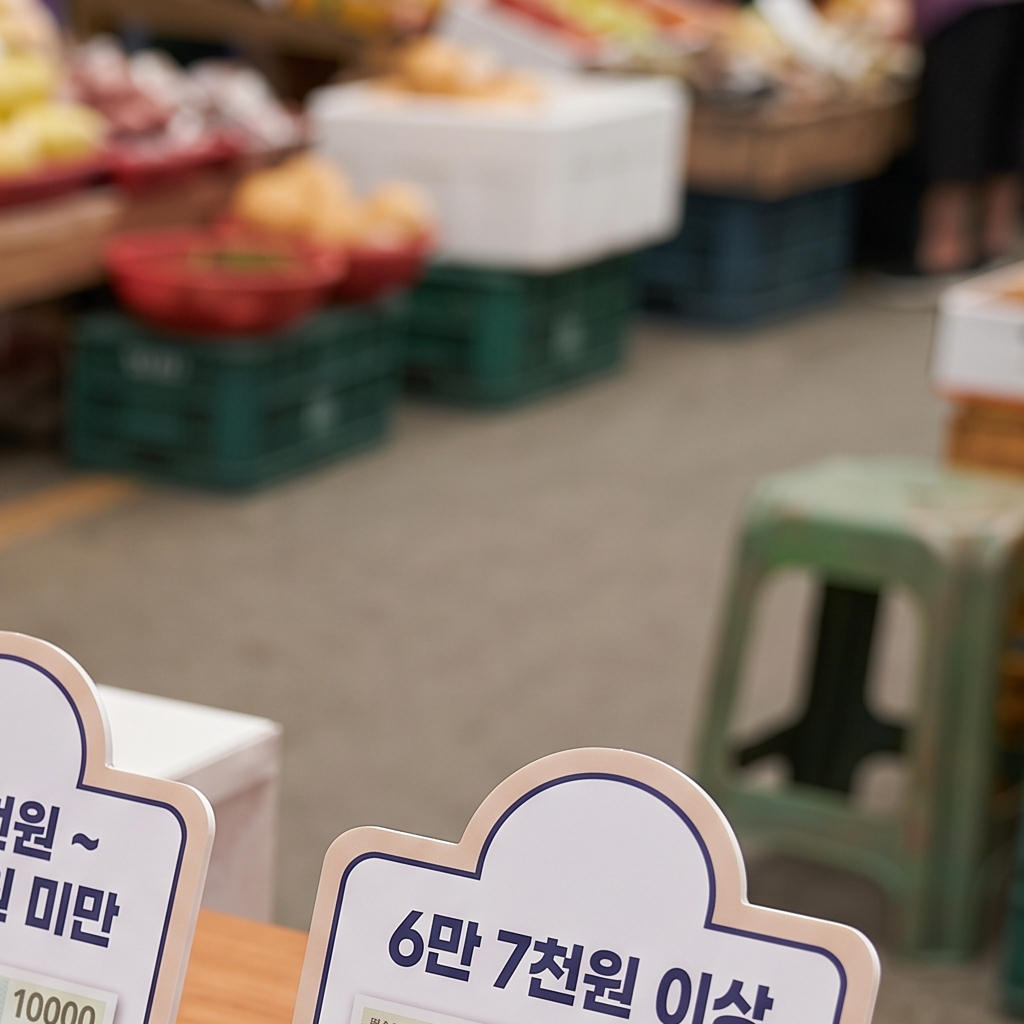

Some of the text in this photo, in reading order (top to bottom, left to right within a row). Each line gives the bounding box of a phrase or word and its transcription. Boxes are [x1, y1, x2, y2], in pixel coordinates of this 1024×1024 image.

[25, 876, 120, 949] 미만
[387, 910, 483, 983] 6만
[493, 930, 641, 1020] 7천원
